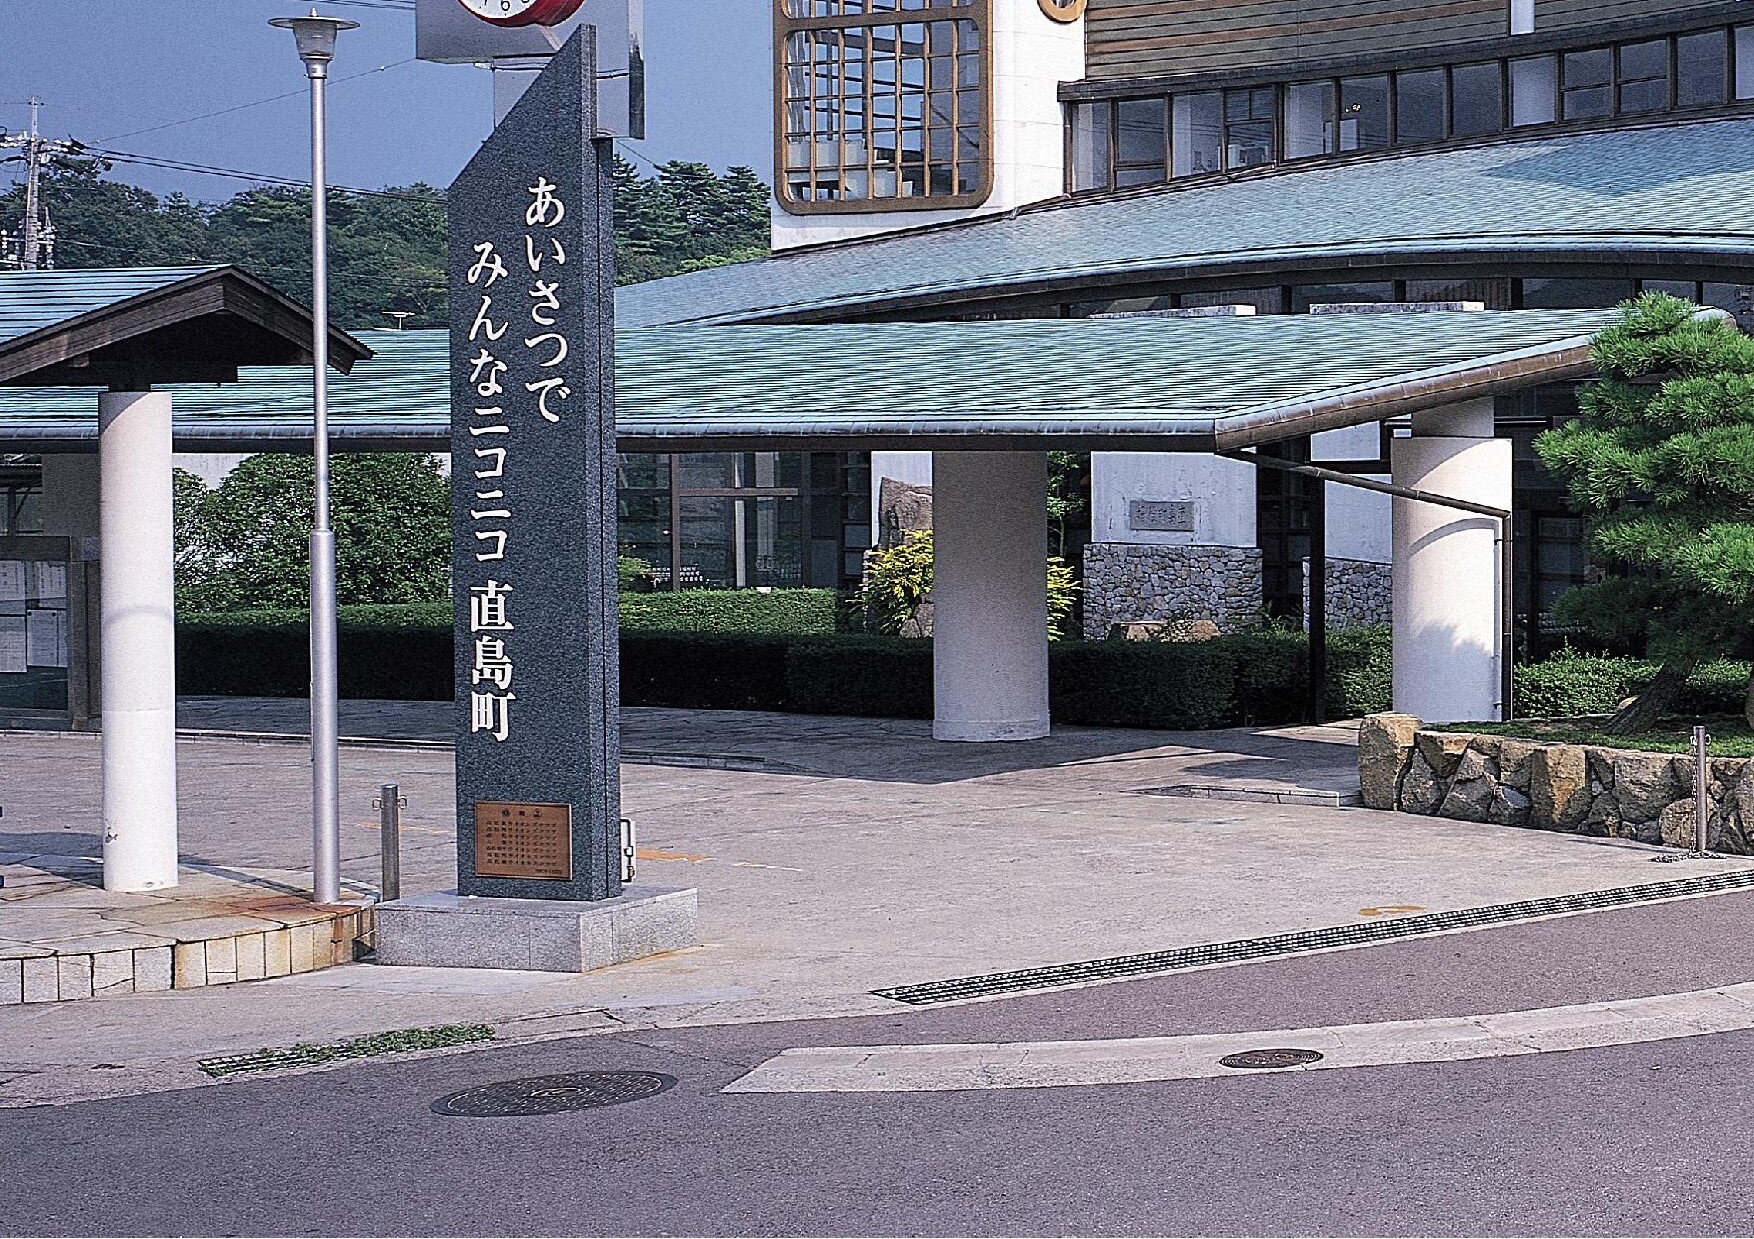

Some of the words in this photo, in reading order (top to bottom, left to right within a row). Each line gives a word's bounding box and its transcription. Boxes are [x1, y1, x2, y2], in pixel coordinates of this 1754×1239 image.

[467, 241, 512, 562] みんなニコニコ
[524, 176, 571, 423] あいさつで
[469, 579, 517, 742] 直島町
